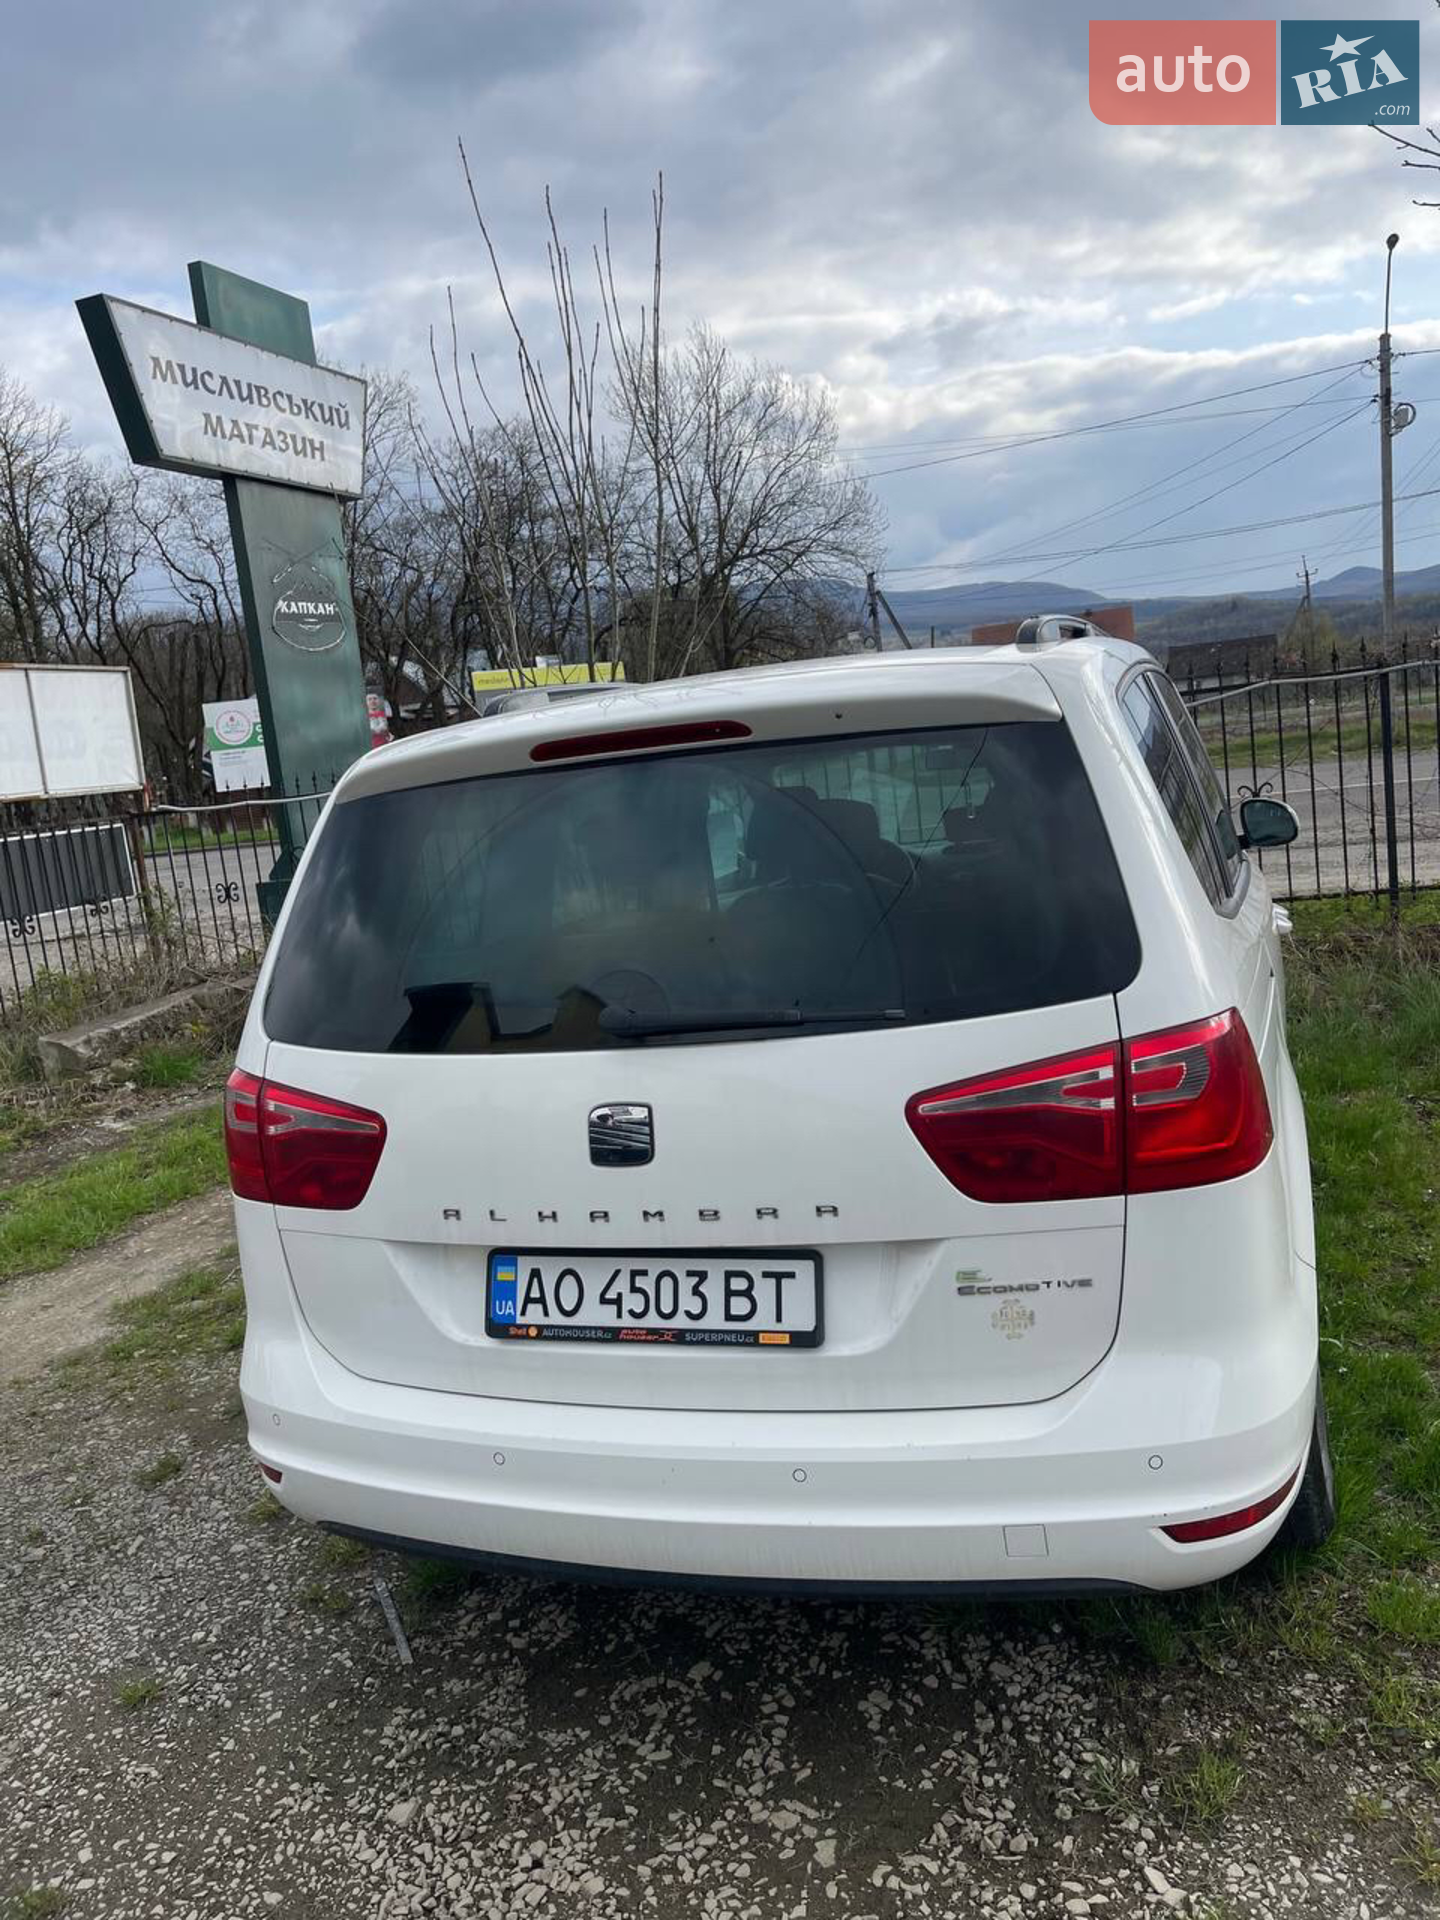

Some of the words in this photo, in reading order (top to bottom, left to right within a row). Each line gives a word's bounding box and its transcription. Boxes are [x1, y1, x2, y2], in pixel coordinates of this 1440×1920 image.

[150, 356, 350, 431] МИСЛИВСЬКИЙ
[202, 412, 326, 462] МАГАЗИН
[281, 601, 335, 616] КАПКАН
[443, 1205, 839, 1223] ALHAMBRA
[495, 1299, 515, 1316] UA
[519, 1266, 585, 1318] AO
[599, 1268, 708, 1320] 4503
[723, 1269, 796, 1323] BT
